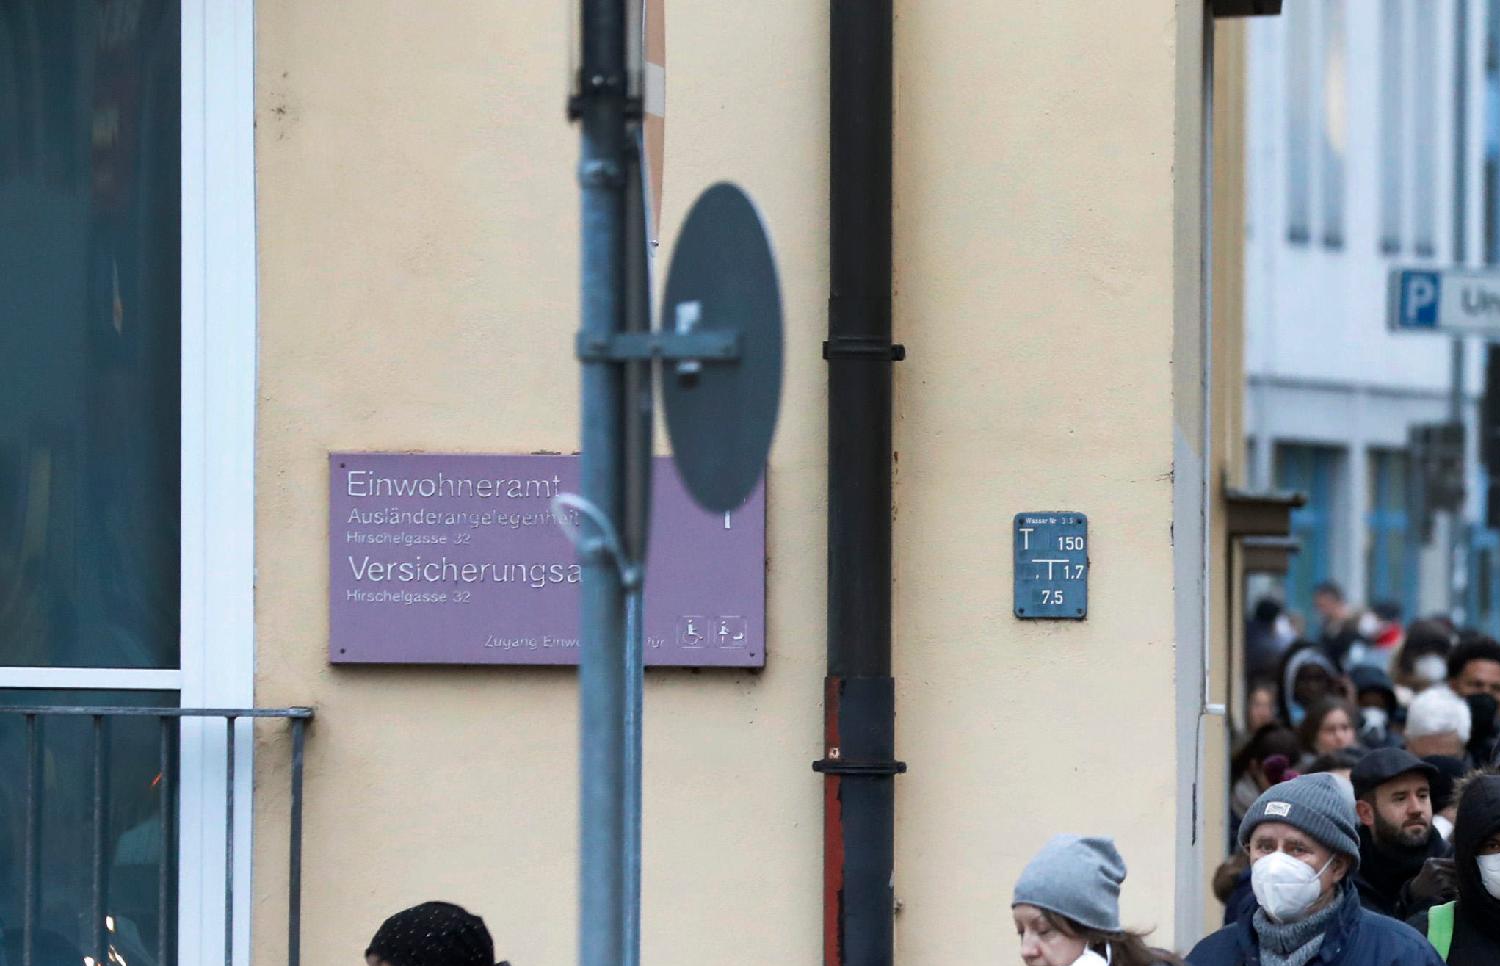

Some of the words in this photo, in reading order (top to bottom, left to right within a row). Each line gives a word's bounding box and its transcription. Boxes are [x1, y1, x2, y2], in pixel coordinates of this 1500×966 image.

[1406, 275, 1435, 323] P
[347, 470, 561, 498] Einwohneramt
[346, 531, 447, 547] Hirschelgasse
[1058, 536, 1084, 551] 150
[346, 589, 447, 605] Hirschelgasse
[453, 590, 471, 603] 32
[484, 634, 537, 651] Zugang
